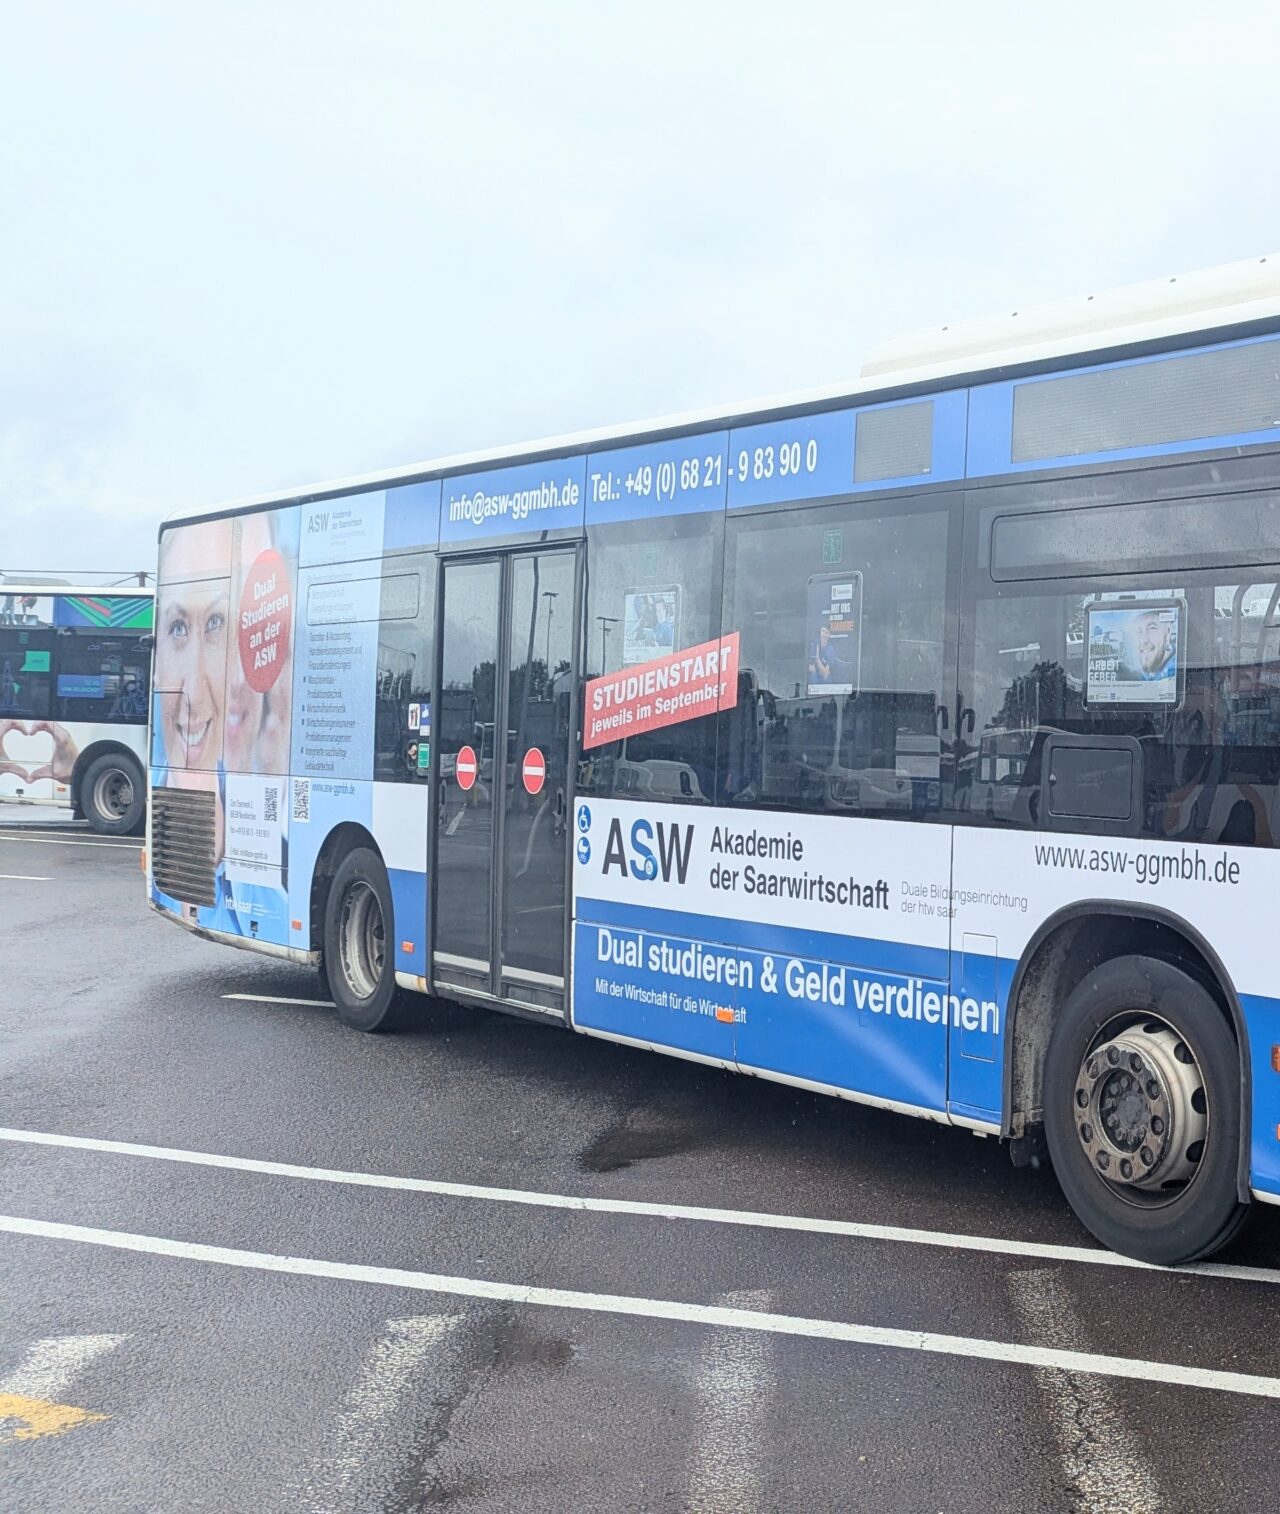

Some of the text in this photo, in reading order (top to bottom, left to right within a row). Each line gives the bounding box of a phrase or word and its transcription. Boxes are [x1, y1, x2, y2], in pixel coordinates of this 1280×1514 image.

[591, 439, 817, 502] Tel.: +49 (0) 68 21 - 9 83 90 0
[450, 478, 579, 525] info@asw-ggmbh.de
[307, 513, 330, 533] ASW
[254, 572, 276, 601] Dual
[241, 594, 289, 629] Studieren
[249, 621, 281, 648] an der
[254, 643, 277, 670] ASW
[1089, 659, 1119, 671] ARBEIT
[593, 646, 731, 711] STUDIENSTART
[1089, 671, 1116, 682] GEBER
[591, 681, 727, 738] jeweils im September
[602, 817, 695, 886] ASW
[710, 825, 803, 861] Akademie
[1035, 845, 1240, 886] www.asw-ggmbh.de
[710, 862, 890, 910] der Saarwirtschaft
[901, 880, 1028, 913] Duale Bildungseinrichtung
[901, 900, 958, 920] der htw saar
[595, 977, 608, 993] Mit
[609, 981, 624, 997] der
[625, 983, 668, 1008] Wirtschaft
[669, 992, 682, 1010] für
[683, 996, 698, 1013] die
[598, 928, 1000, 1035] Dual studieren & Geld verdienen
